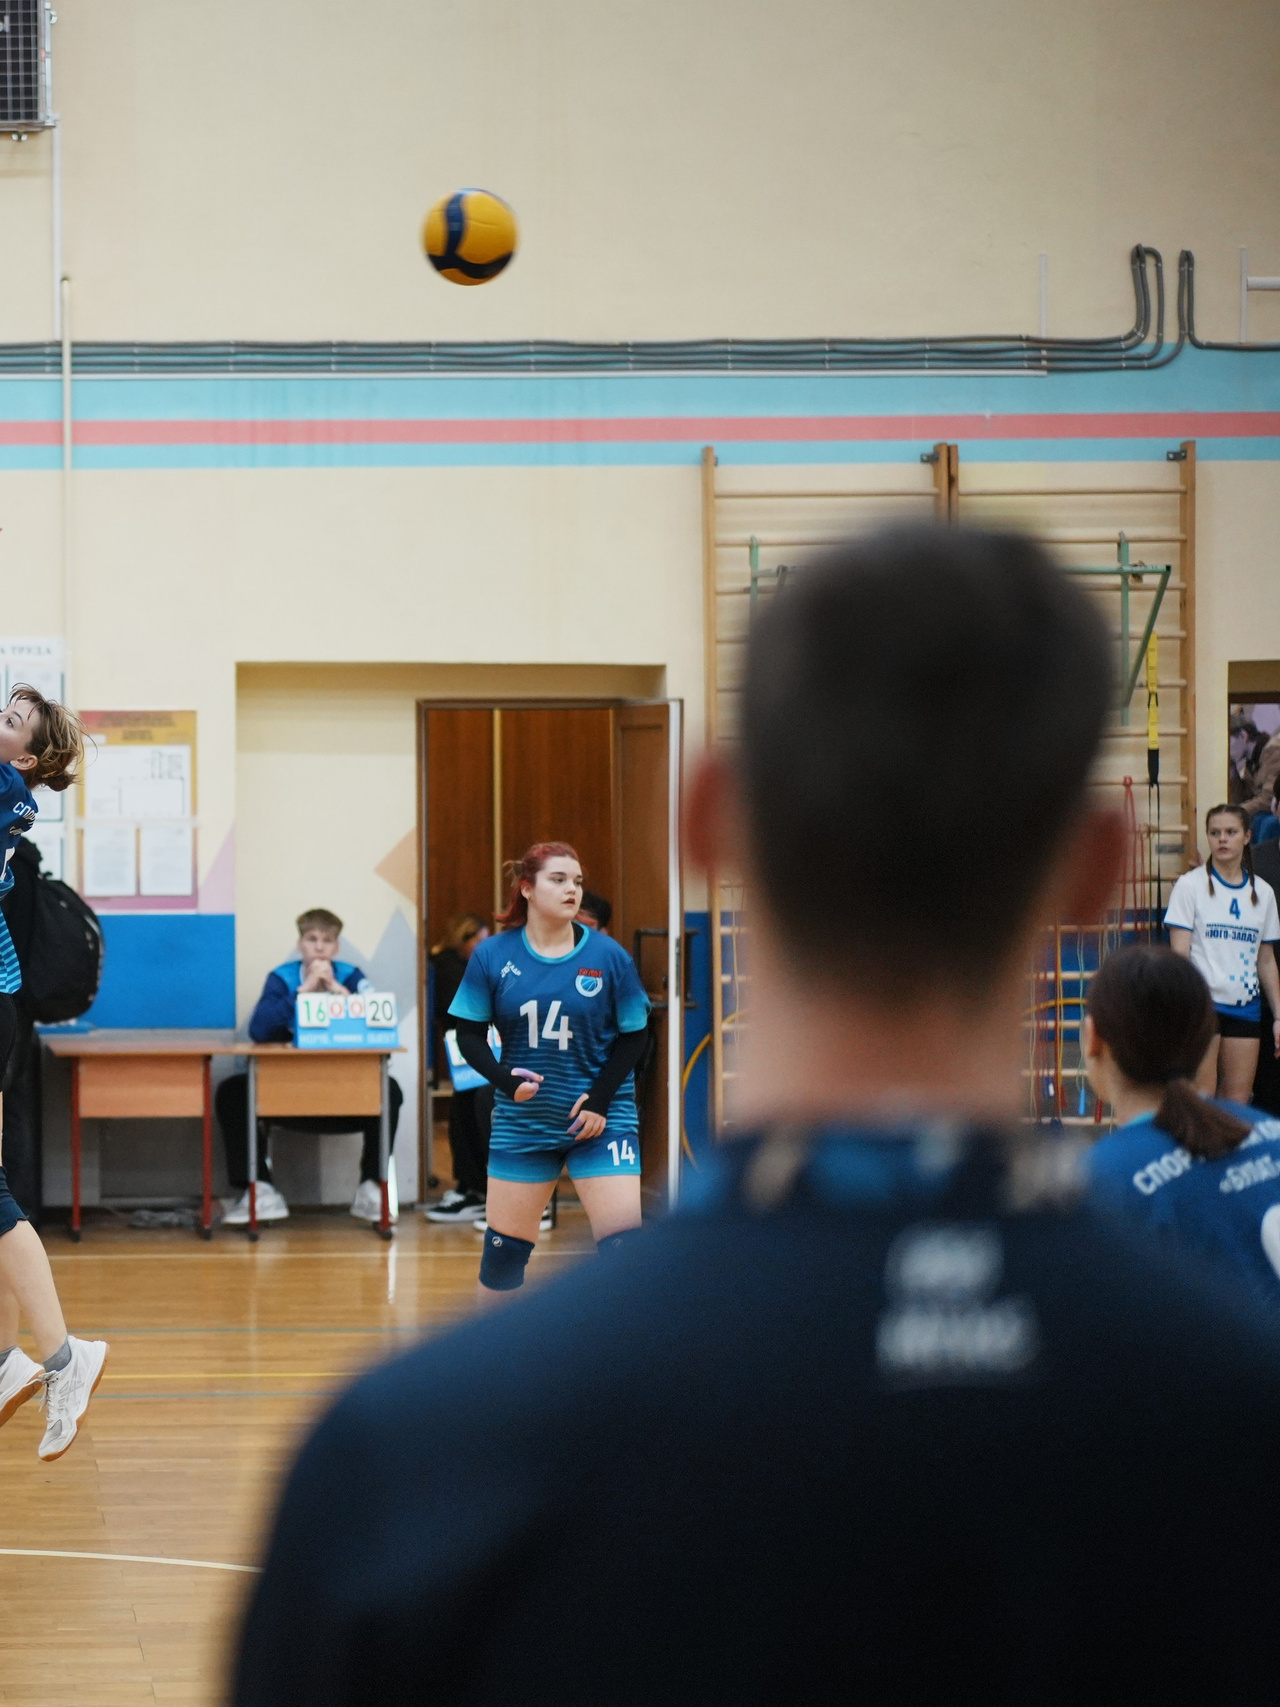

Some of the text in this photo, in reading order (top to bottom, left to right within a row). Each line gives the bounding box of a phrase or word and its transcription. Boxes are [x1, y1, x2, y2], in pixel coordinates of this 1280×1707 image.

[1229, 897, 1241, 920] 4
[304, 1000, 326, 1023] 16
[369, 999, 393, 1022] 20
[519, 999, 573, 1051] 14
[607, 1139, 636, 1166] 14
